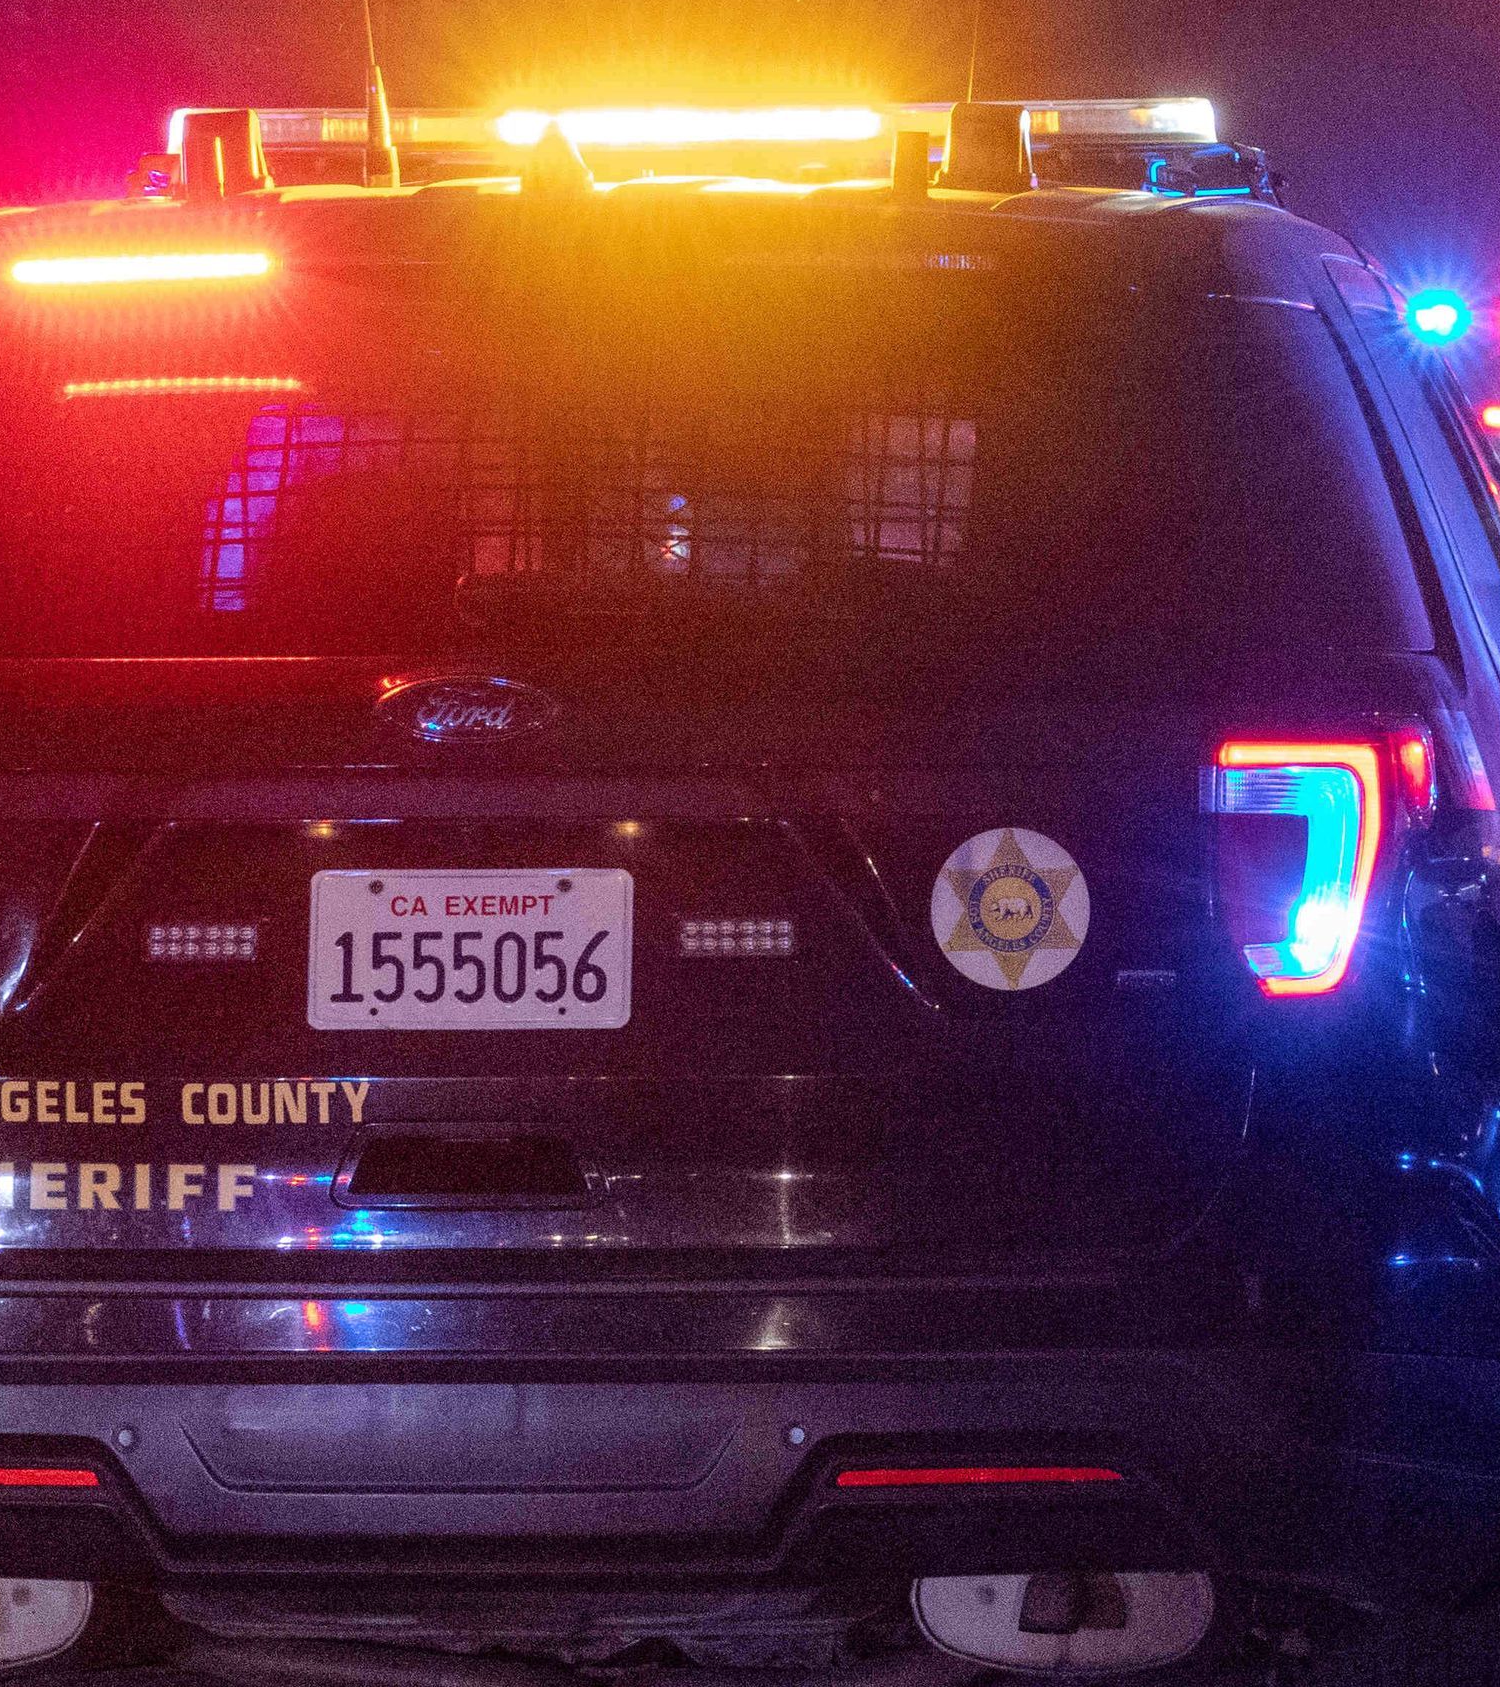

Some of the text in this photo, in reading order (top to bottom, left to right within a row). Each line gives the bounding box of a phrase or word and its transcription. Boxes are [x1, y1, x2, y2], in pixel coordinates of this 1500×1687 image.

[417, 695, 516, 729] Ford
[391, 895, 554, 917] CA EXEMPT
[330, 930, 610, 1003] 1555056
[182, 1081, 370, 1125] COUNTY
